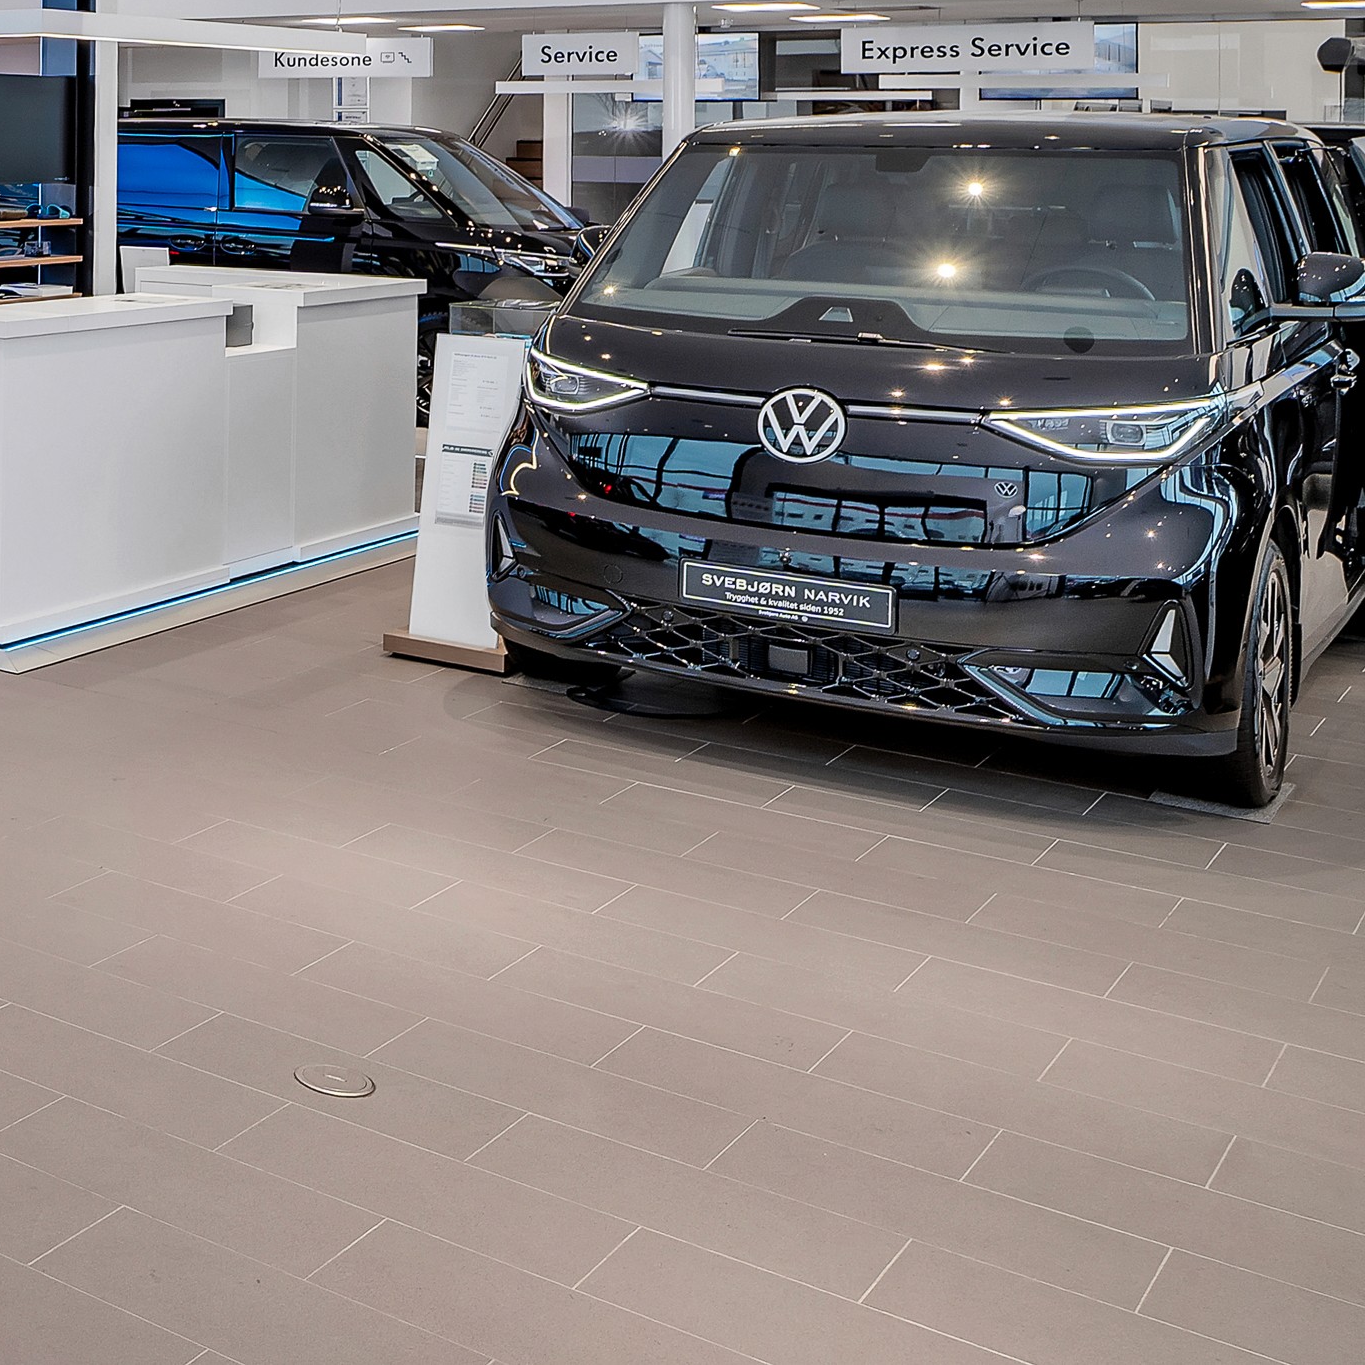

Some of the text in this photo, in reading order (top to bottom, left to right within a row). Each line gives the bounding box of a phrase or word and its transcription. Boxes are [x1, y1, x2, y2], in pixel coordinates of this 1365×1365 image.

[274, 52, 372, 67] Kundesone
[540, 45, 618, 64] Service
[861, 36, 1070, 65] Express Service
[758, 388, 846, 464] VW
[701, 573, 871, 608] SVEBJØRN NARVIK
[725, 592, 759, 604] Trygghet
[768, 598, 798, 610] kvalitet
[799, 602, 821, 613] siden
[823, 606, 844, 617] 1952
